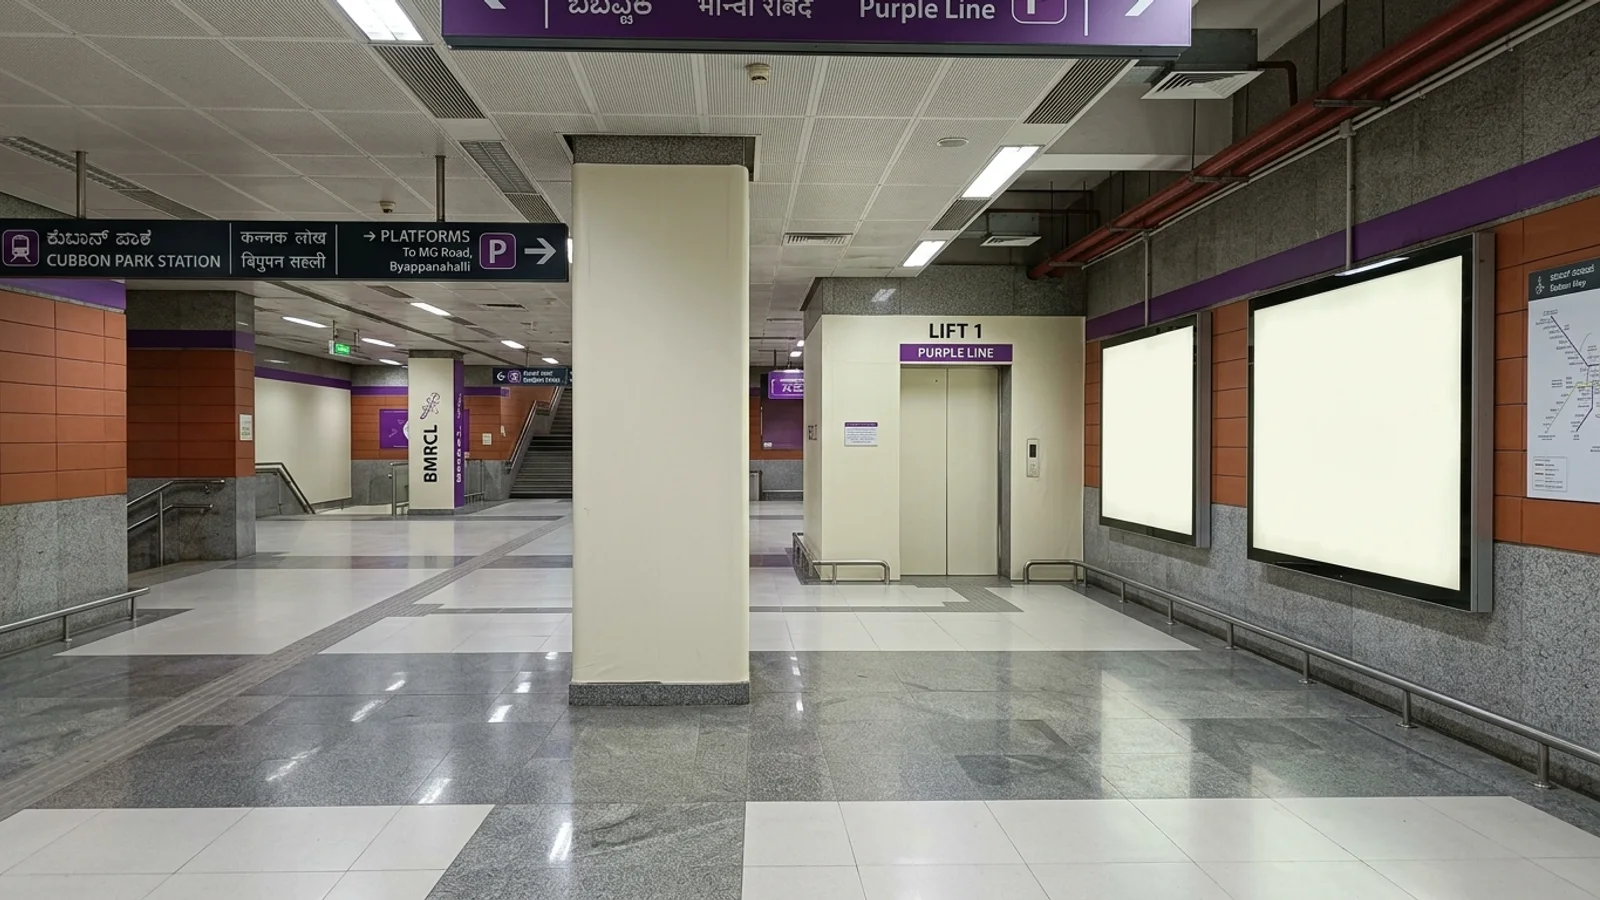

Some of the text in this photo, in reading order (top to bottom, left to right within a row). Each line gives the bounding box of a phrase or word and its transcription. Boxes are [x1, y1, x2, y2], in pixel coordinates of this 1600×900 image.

[860, 0, 996, 24] Purple Line
[380, 230, 470, 243] PLATFORMS
[403, 247, 473, 259] To MG Road,
[46, 254, 221, 268] CUBBON PARK STATION
[389, 261, 471, 275] Byappanahalli
[929, 323, 982, 339] LIFT 1
[918, 347, 994, 358] PURPLE LINE
[423, 424, 438, 483] BMRCL
